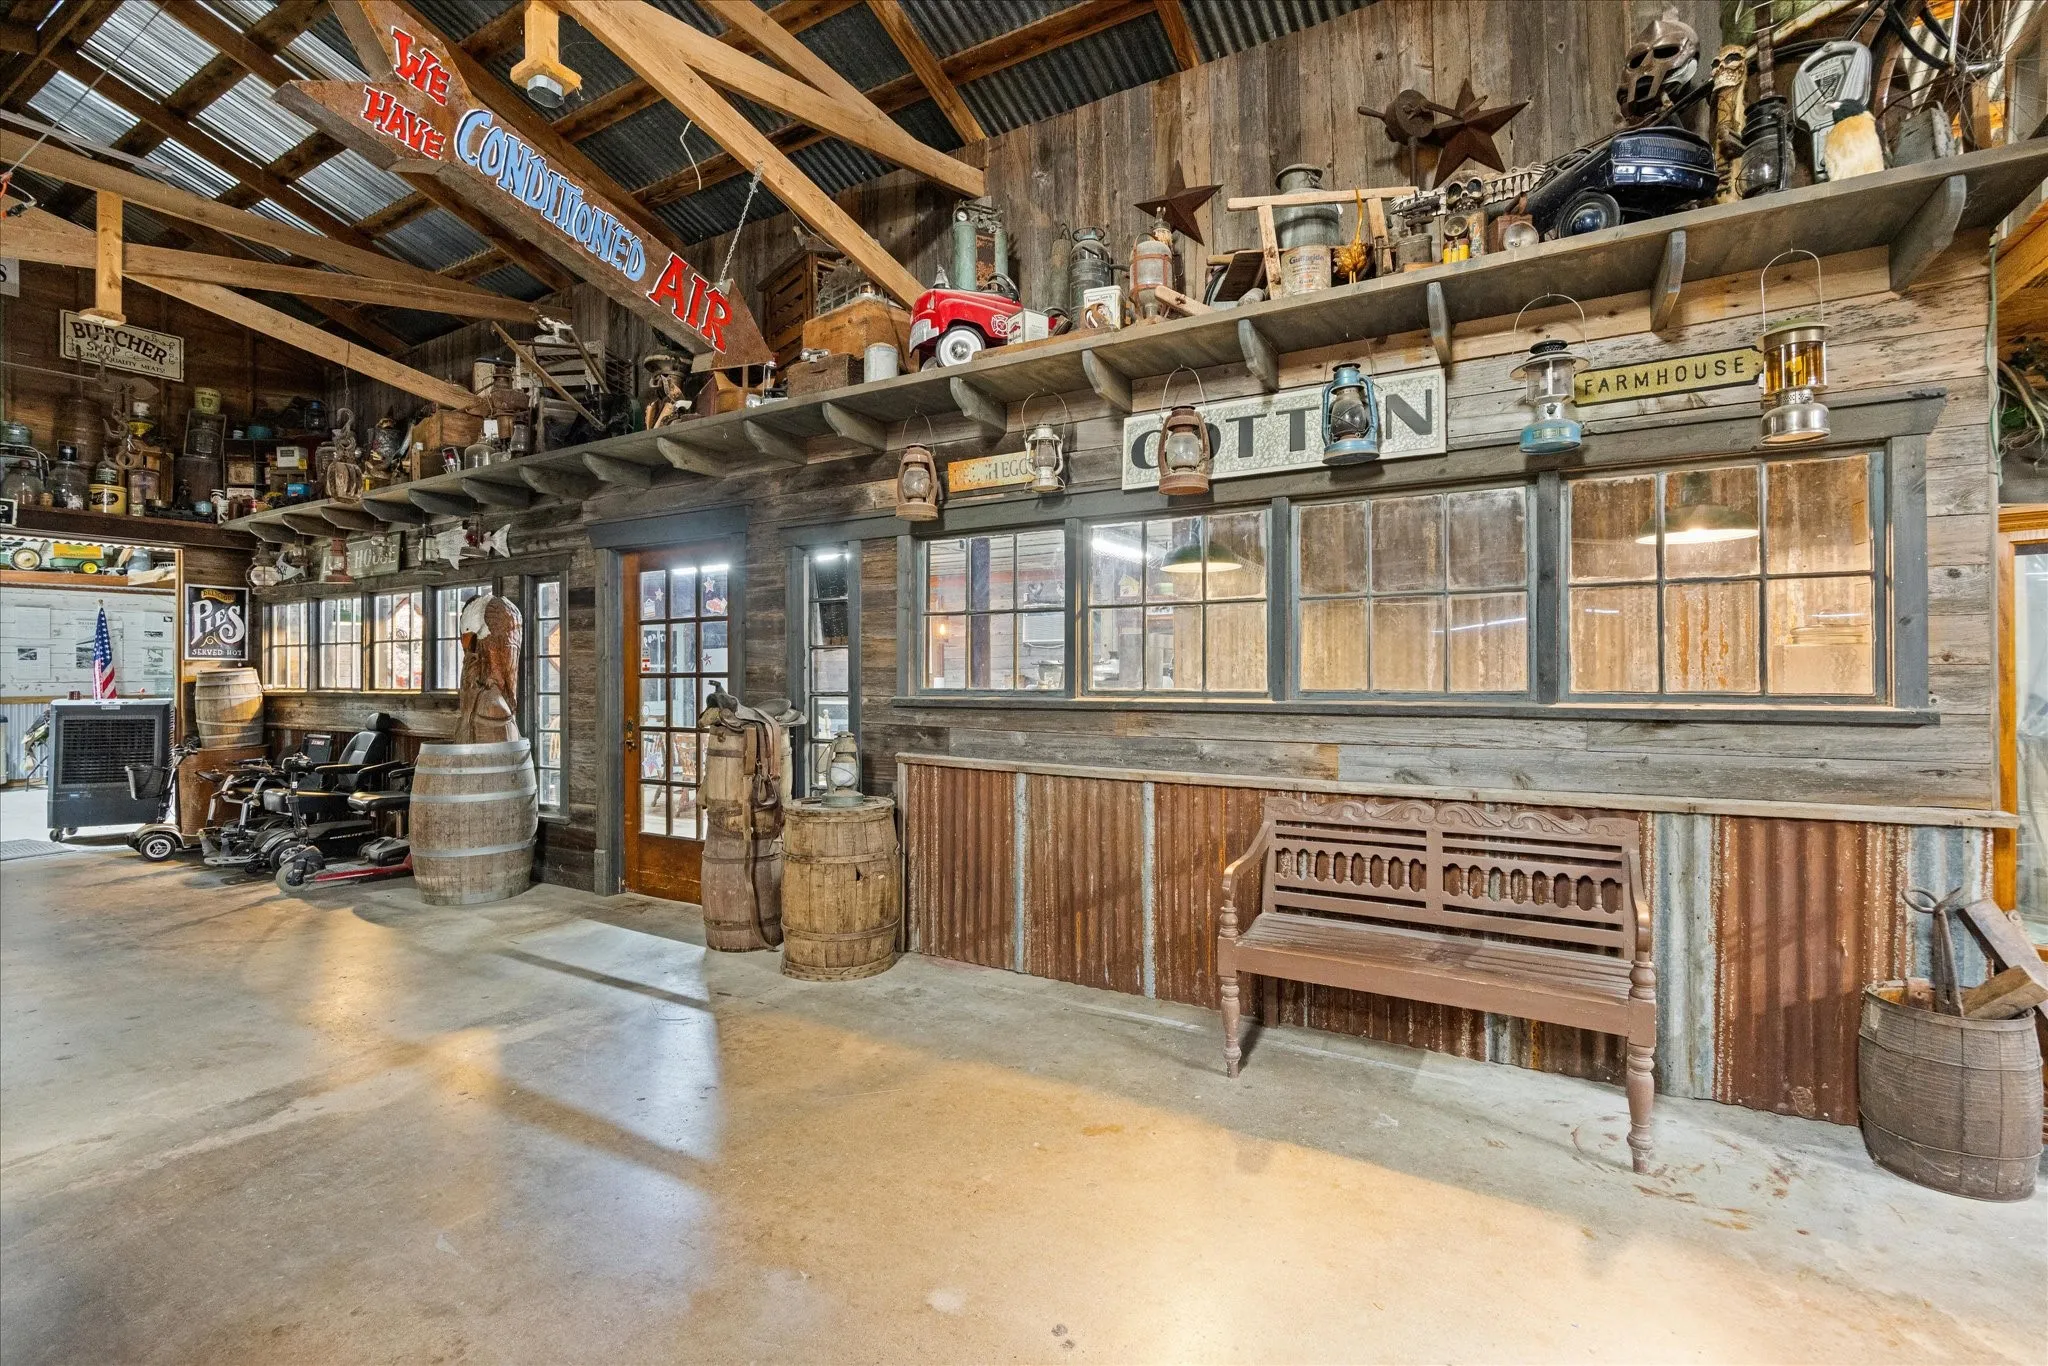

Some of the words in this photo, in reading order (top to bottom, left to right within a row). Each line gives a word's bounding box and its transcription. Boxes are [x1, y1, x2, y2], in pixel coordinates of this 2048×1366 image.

[391, 25, 452, 107] WE
[362, 84, 446, 160] HAVE
[454, 109, 647, 282] CONDITIONED
[646, 252, 734, 354] AIR
[70, 321, 168, 366] BUTCHER
[1584, 356, 1745, 396] FARMHOUSE
[1130, 388, 1433, 470] CTTN
[1002, 457, 1033, 478] EGG
